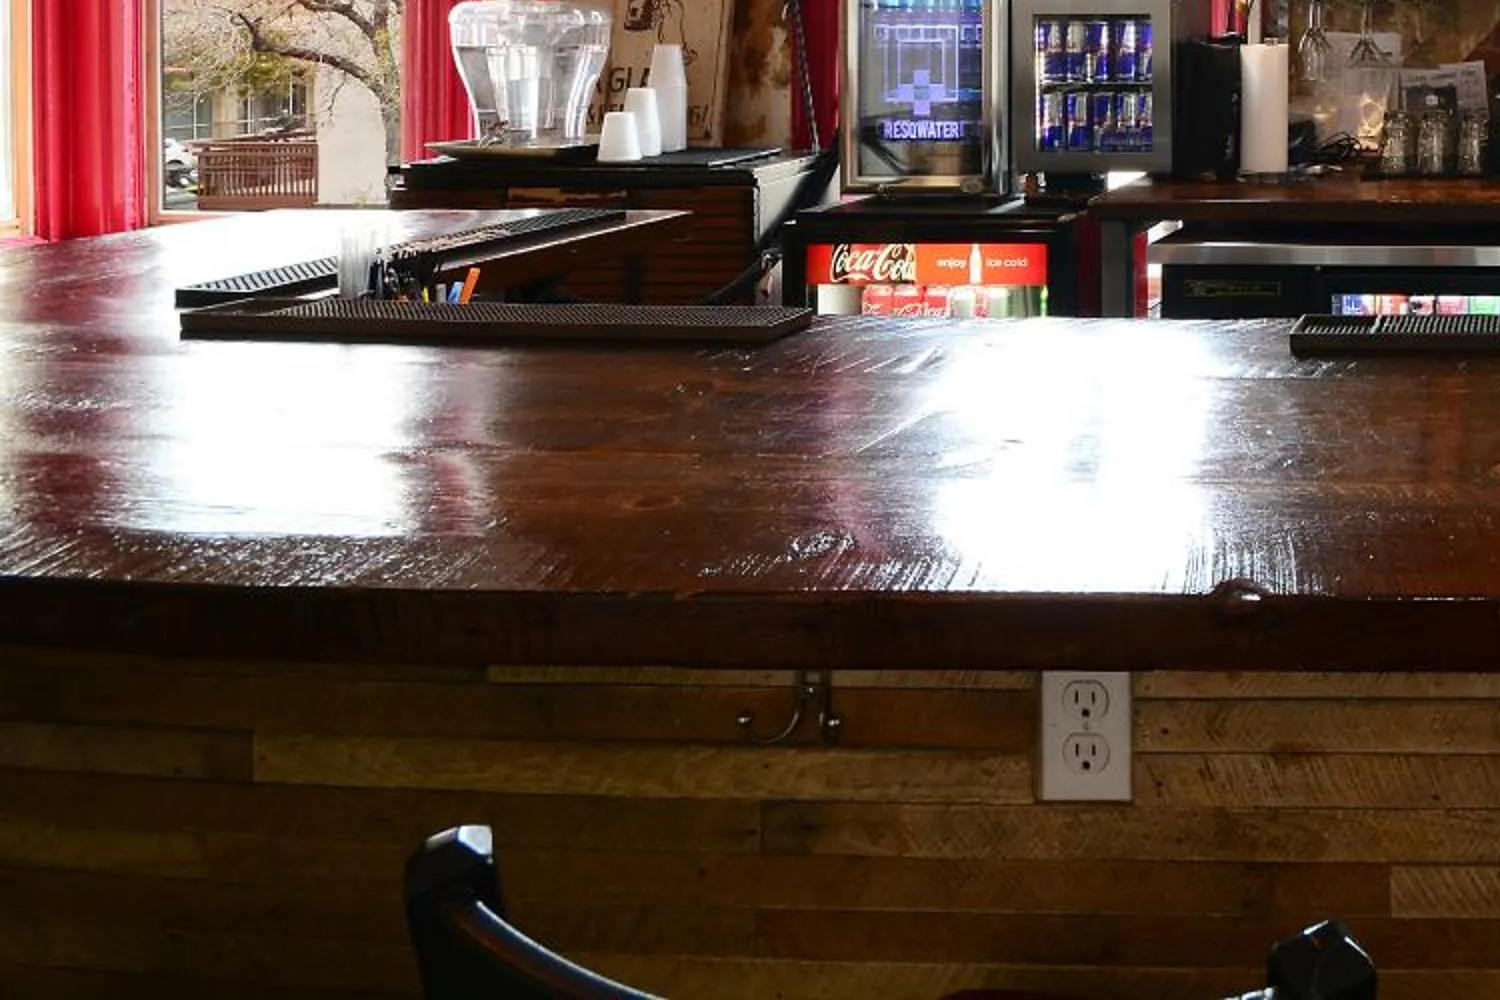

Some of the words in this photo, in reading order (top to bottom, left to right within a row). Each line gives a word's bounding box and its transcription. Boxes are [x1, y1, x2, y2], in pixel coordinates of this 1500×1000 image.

[883, 120, 960, 139] RESQWATER
[936, 257, 967, 270] enjoy
[986, 257, 1002, 268] ice
[1003, 257, 1029, 268] cold
